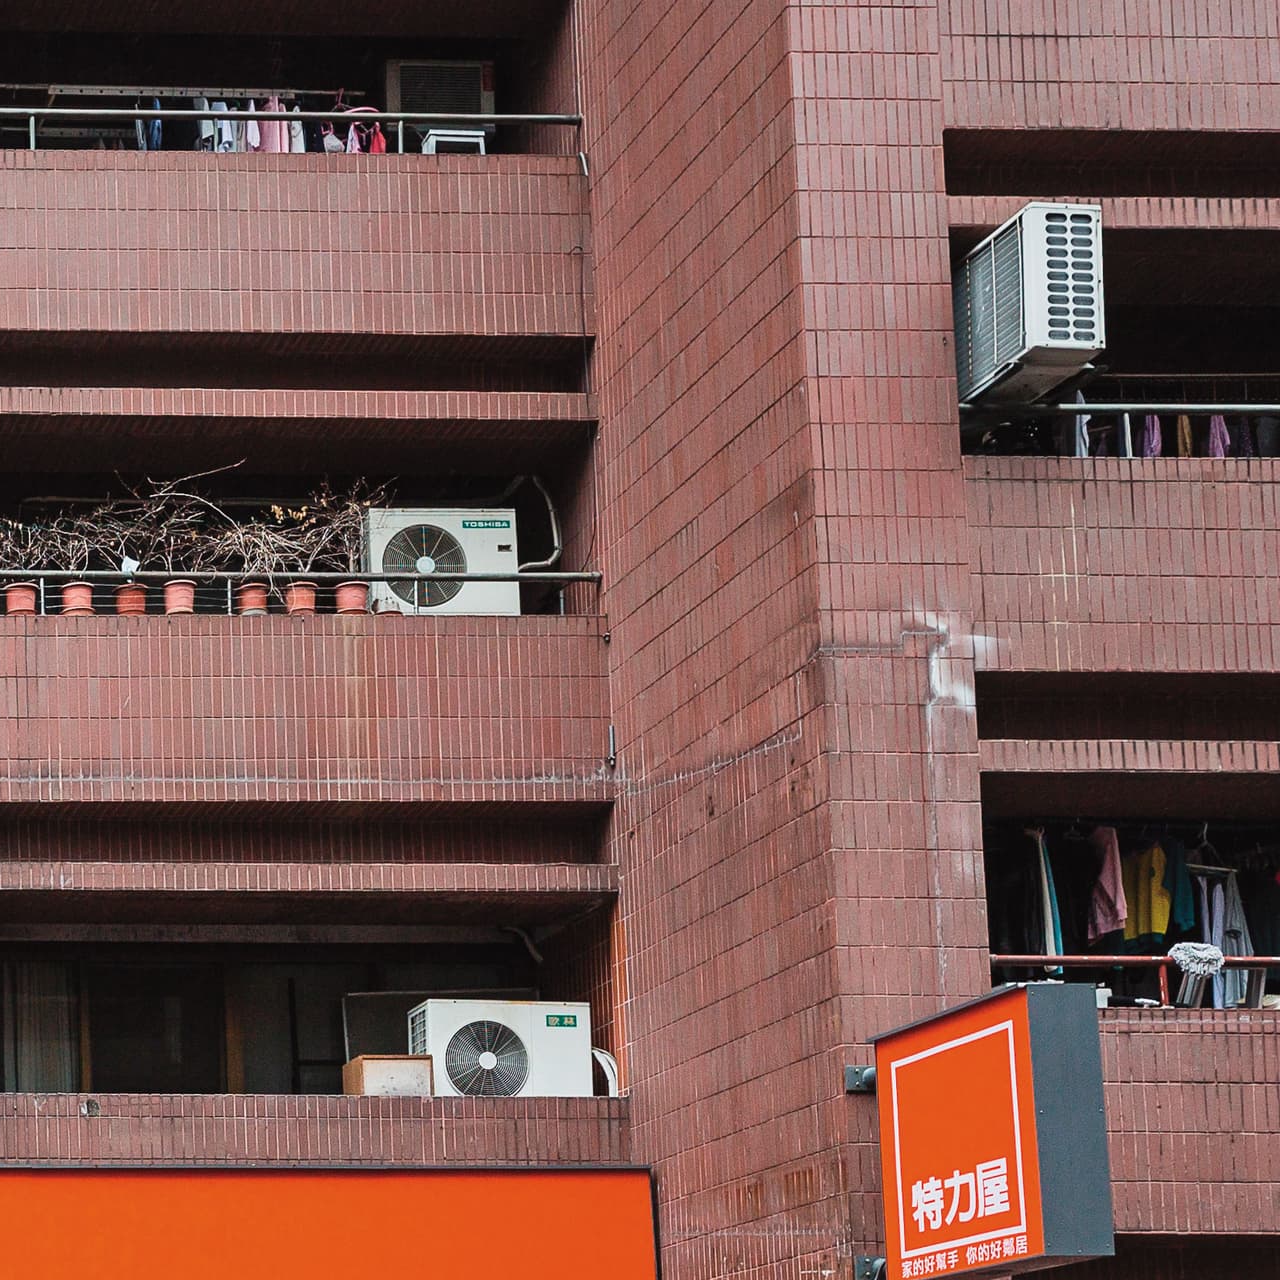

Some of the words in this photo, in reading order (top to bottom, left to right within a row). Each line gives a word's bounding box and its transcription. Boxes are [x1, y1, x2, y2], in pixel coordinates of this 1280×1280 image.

[911, 1158, 1010, 1232] 特力屋
[901, 1250, 959, 1278] 家的好幫手
[966, 1235, 1028, 1264] 你的好鄰居
